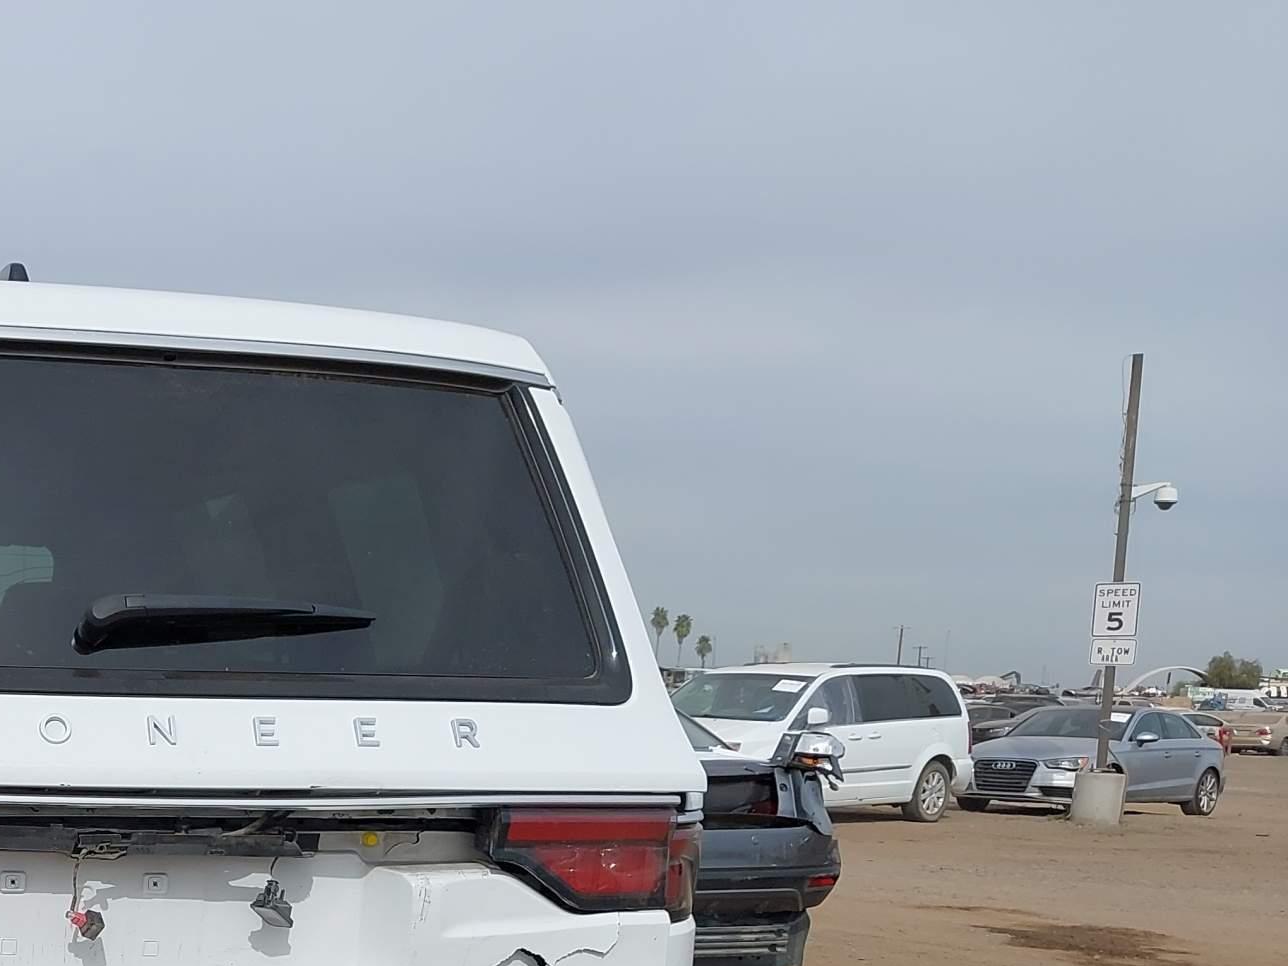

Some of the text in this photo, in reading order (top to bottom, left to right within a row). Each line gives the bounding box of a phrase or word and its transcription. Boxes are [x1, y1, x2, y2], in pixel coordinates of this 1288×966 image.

[1098, 588, 1137, 598] SPEED
[1101, 600, 1132, 609] LIMIT
[1106, 612, 1124, 631] 5
[1111, 647, 1130, 655] TOW
